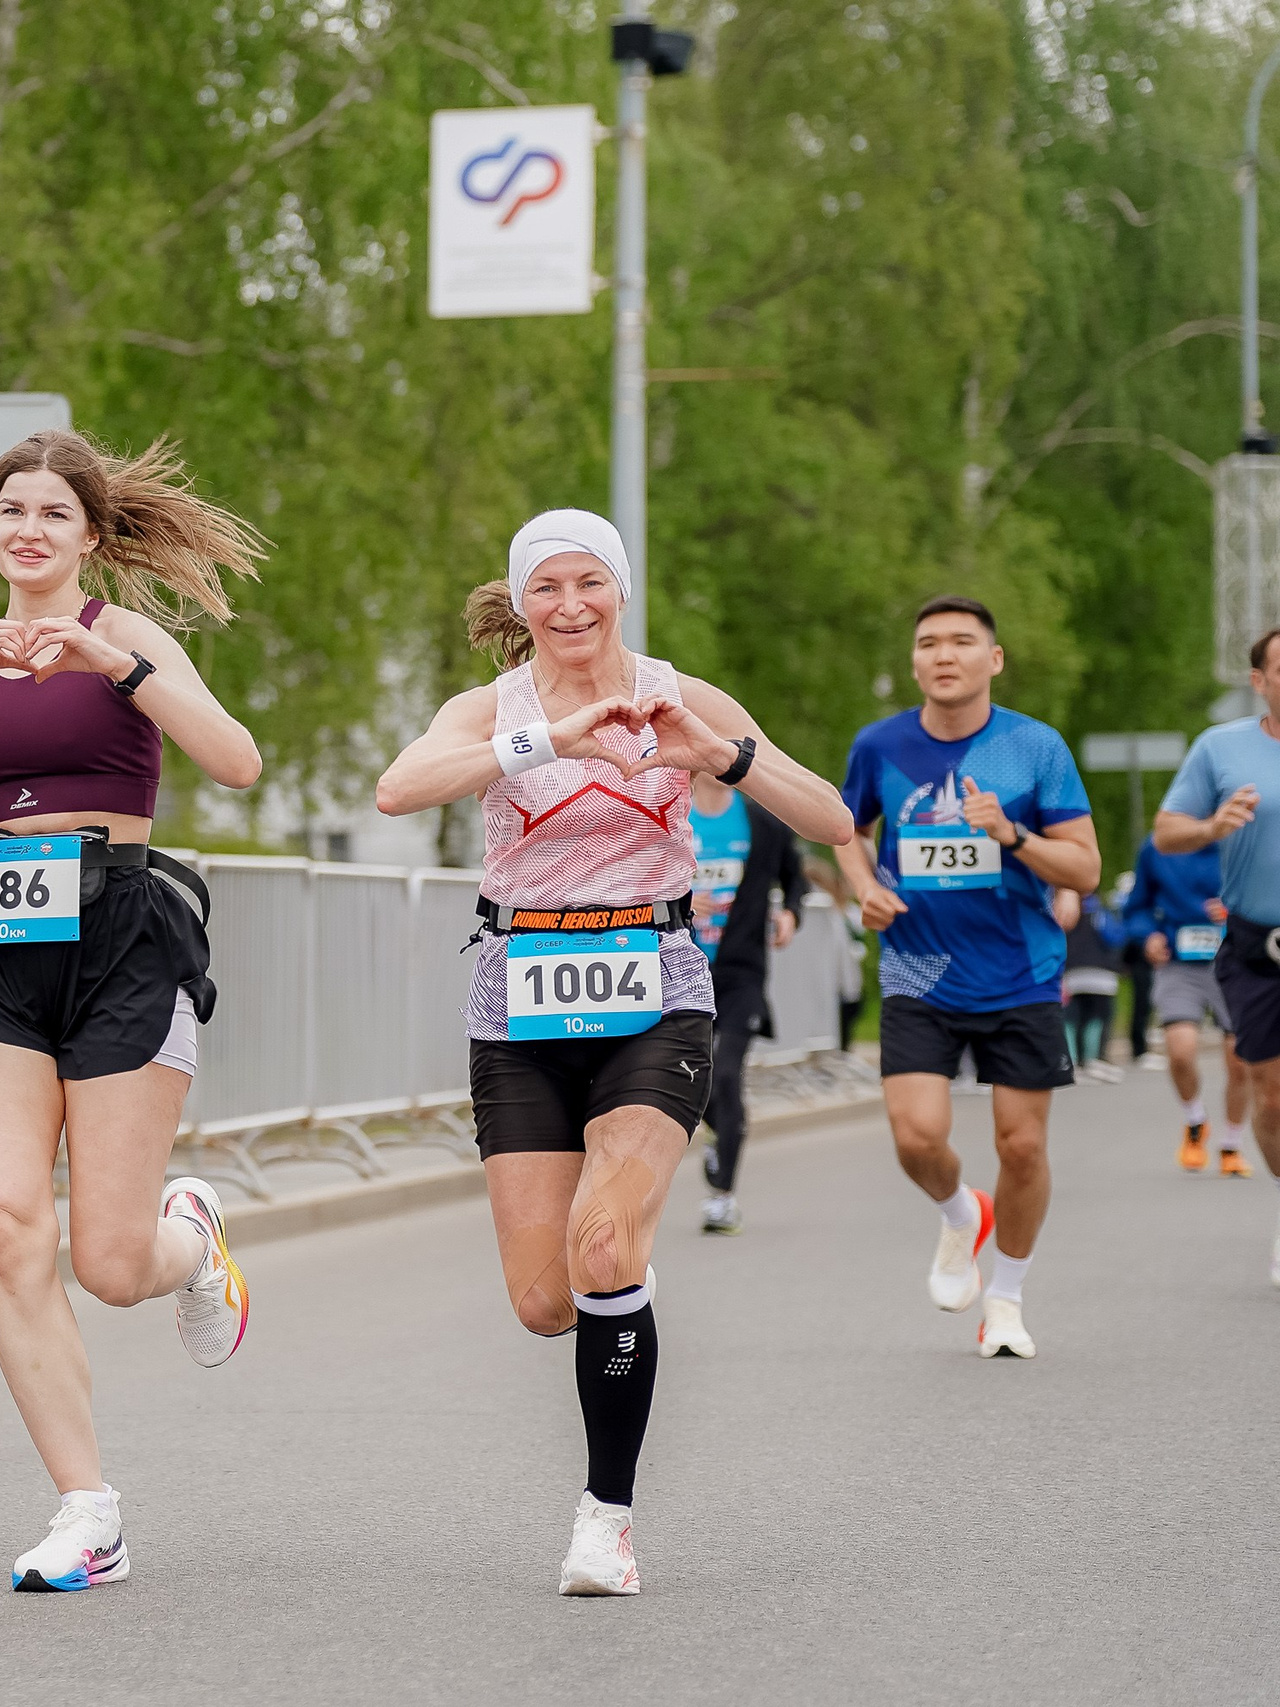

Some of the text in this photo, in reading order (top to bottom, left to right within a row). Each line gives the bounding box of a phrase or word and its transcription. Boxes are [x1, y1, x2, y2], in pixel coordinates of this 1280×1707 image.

[10, 799, 39, 810] DEMIX
[920, 845, 979, 869] 733
[511, 906, 653, 929] RUNNING HEROES RUSSIA
[524, 961, 647, 1005] 1004
